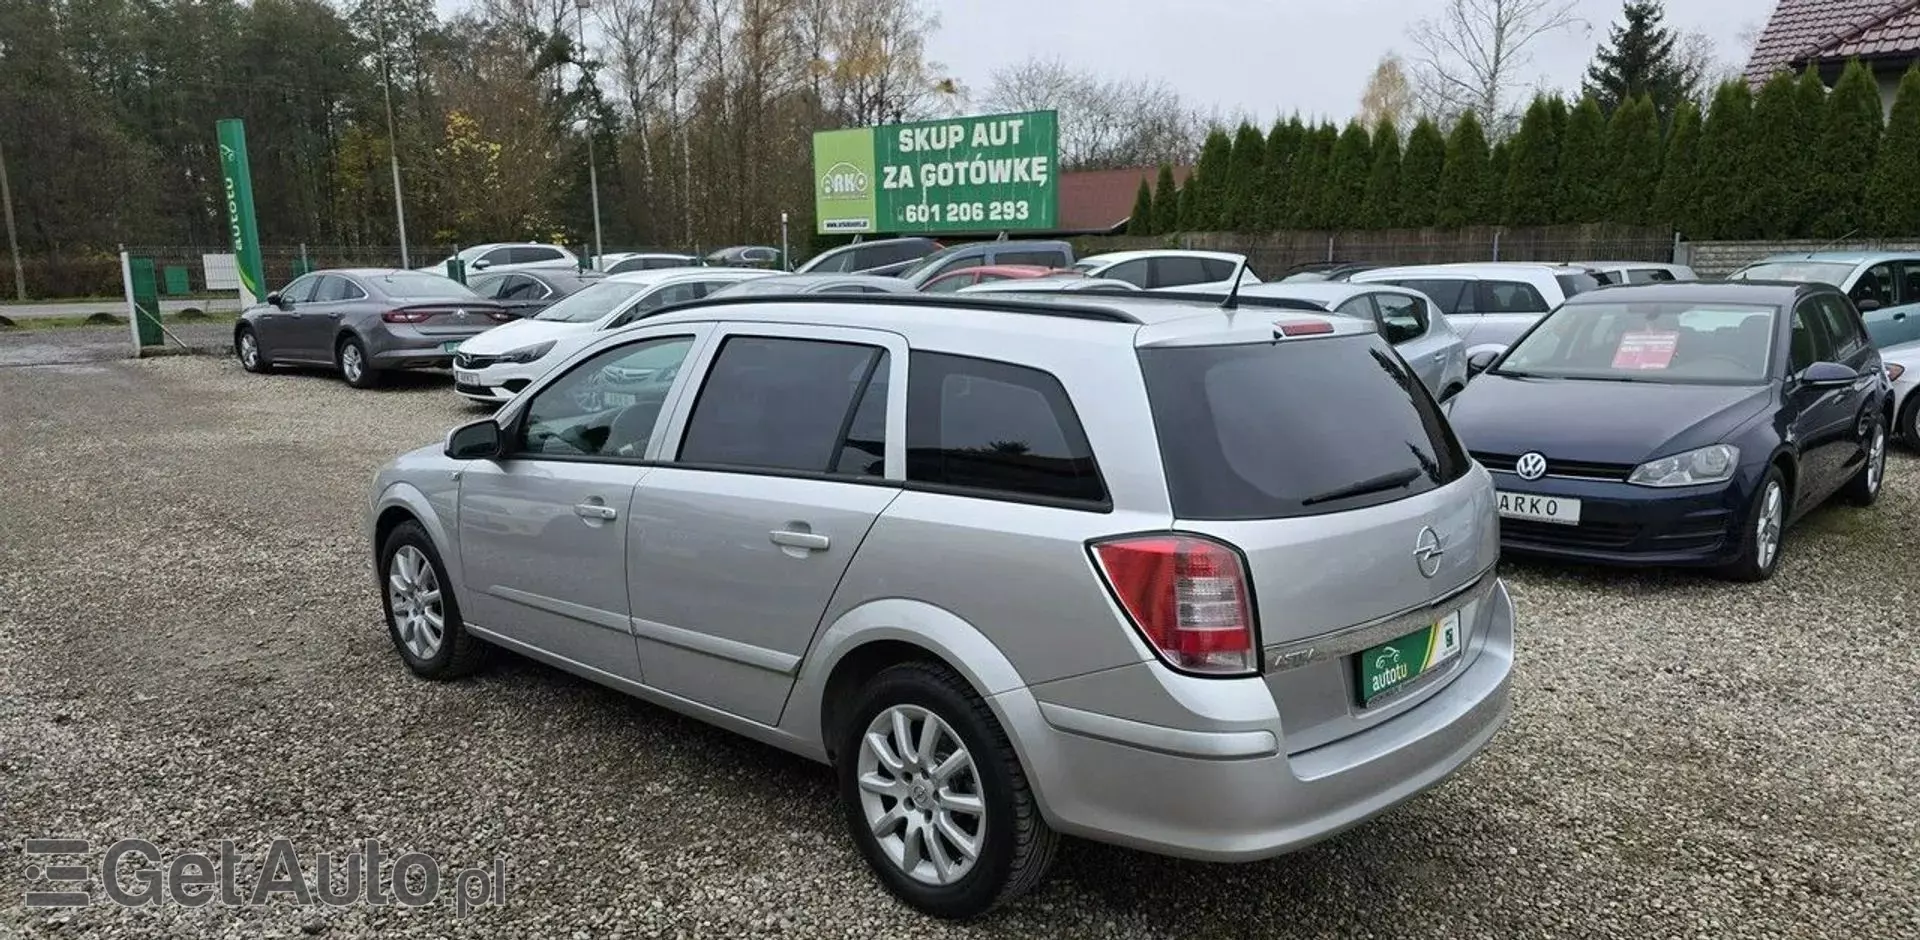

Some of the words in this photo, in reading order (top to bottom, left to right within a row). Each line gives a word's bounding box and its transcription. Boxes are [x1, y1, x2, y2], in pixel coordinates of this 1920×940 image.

[898, 124, 965, 152] SKUP
[971, 119, 1025, 148] AUT
[883, 165, 914, 189] ZA
[920, 152, 1049, 188] GOTÓWKĘ
[224, 176, 243, 251] autotu
[905, 204, 941, 223] 601
[946, 202, 984, 222] 206
[989, 200, 1030, 221] 293
[1499, 494, 1559, 517] ARKO
[1371, 661, 1408, 692] autotu
